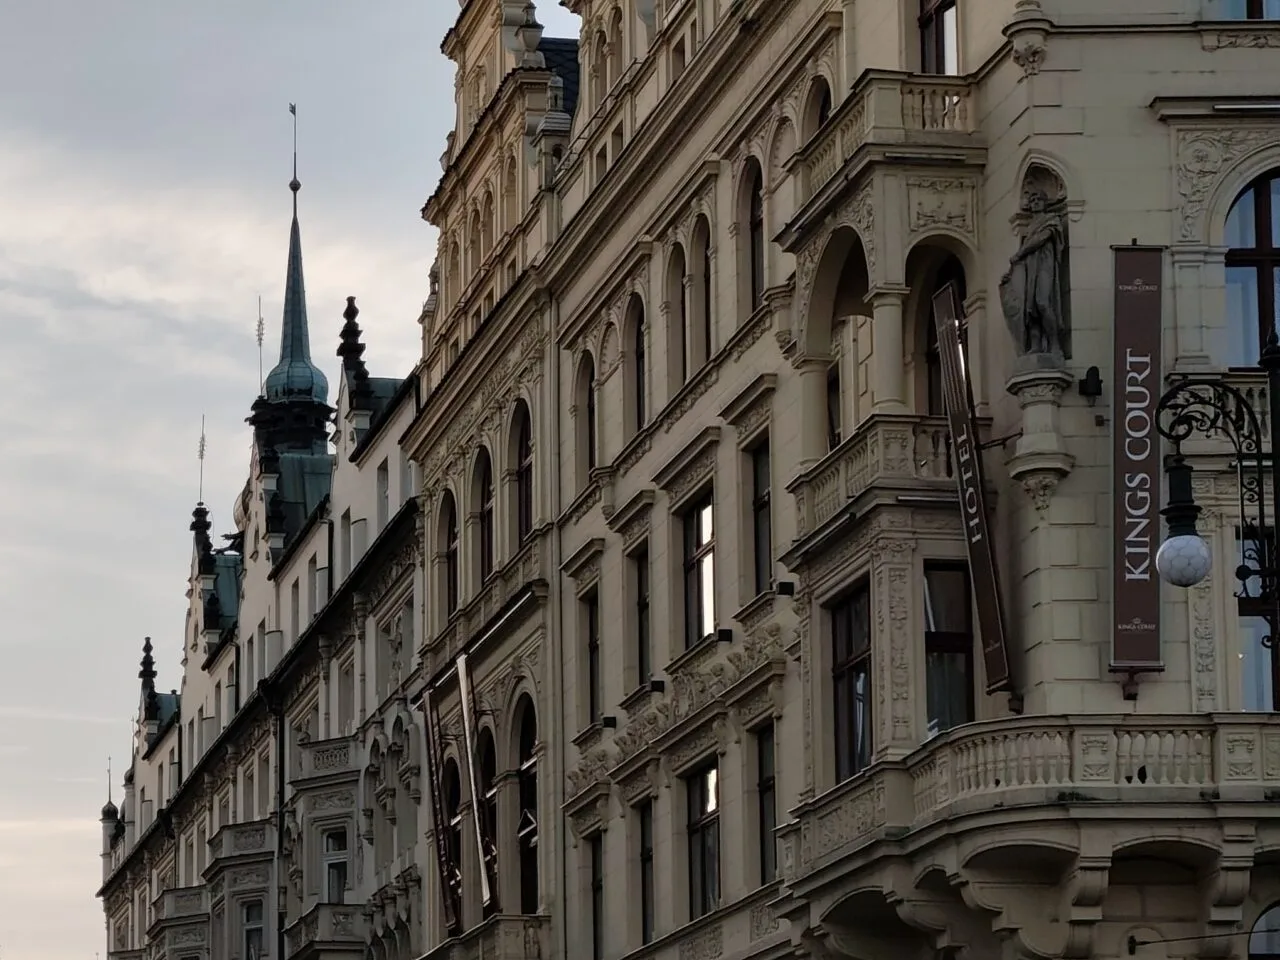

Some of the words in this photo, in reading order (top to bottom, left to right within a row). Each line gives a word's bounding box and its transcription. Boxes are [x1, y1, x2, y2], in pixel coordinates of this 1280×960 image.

[1124, 348, 1152, 462] COURT
[957, 422, 983, 545] HOTEL
[1124, 472, 1152, 582] KINGS
